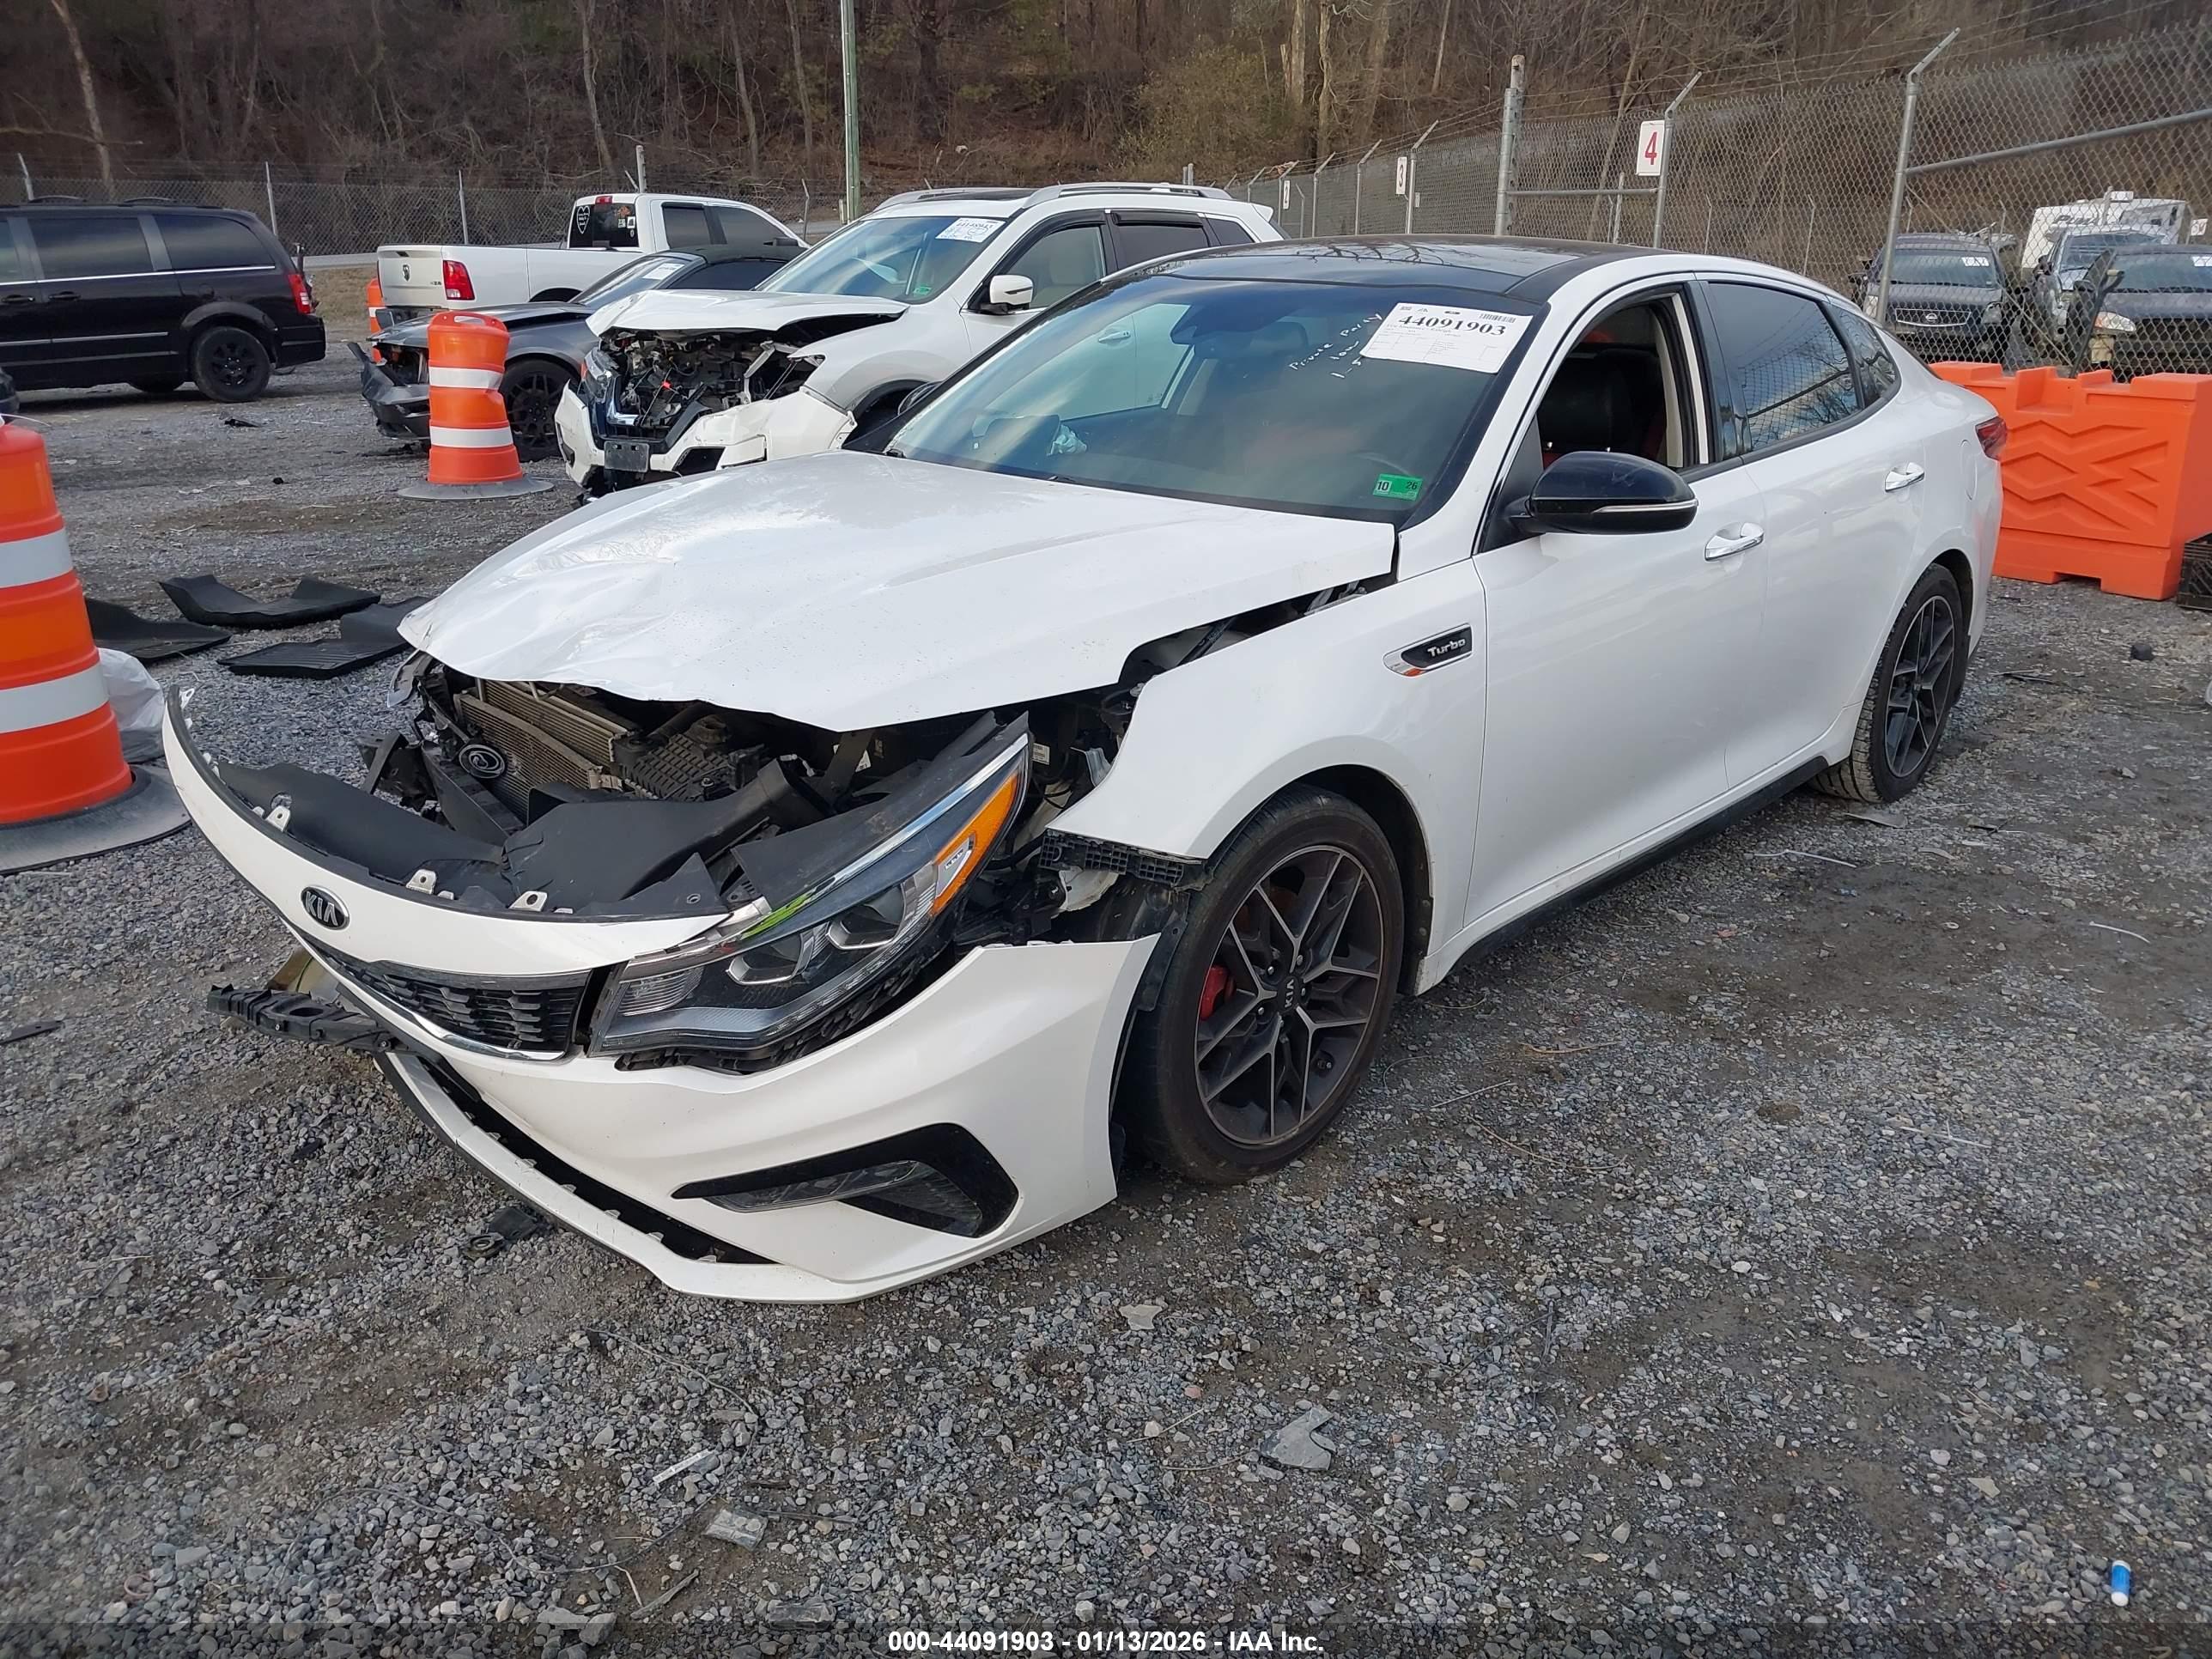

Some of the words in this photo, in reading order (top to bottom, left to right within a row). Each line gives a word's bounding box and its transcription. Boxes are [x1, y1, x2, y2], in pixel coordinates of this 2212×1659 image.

[1644, 131, 1658, 166] 4
[1398, 163, 1405, 189] 3
[1398, 314, 1507, 337] 44091903
[1376, 480, 1390, 491] 10
[1405, 481, 1419, 490] 26
[1427, 638, 1466, 657] Turbo
[305, 890, 338, 926] KIA
[1285, 979, 1294, 1008] KIA
